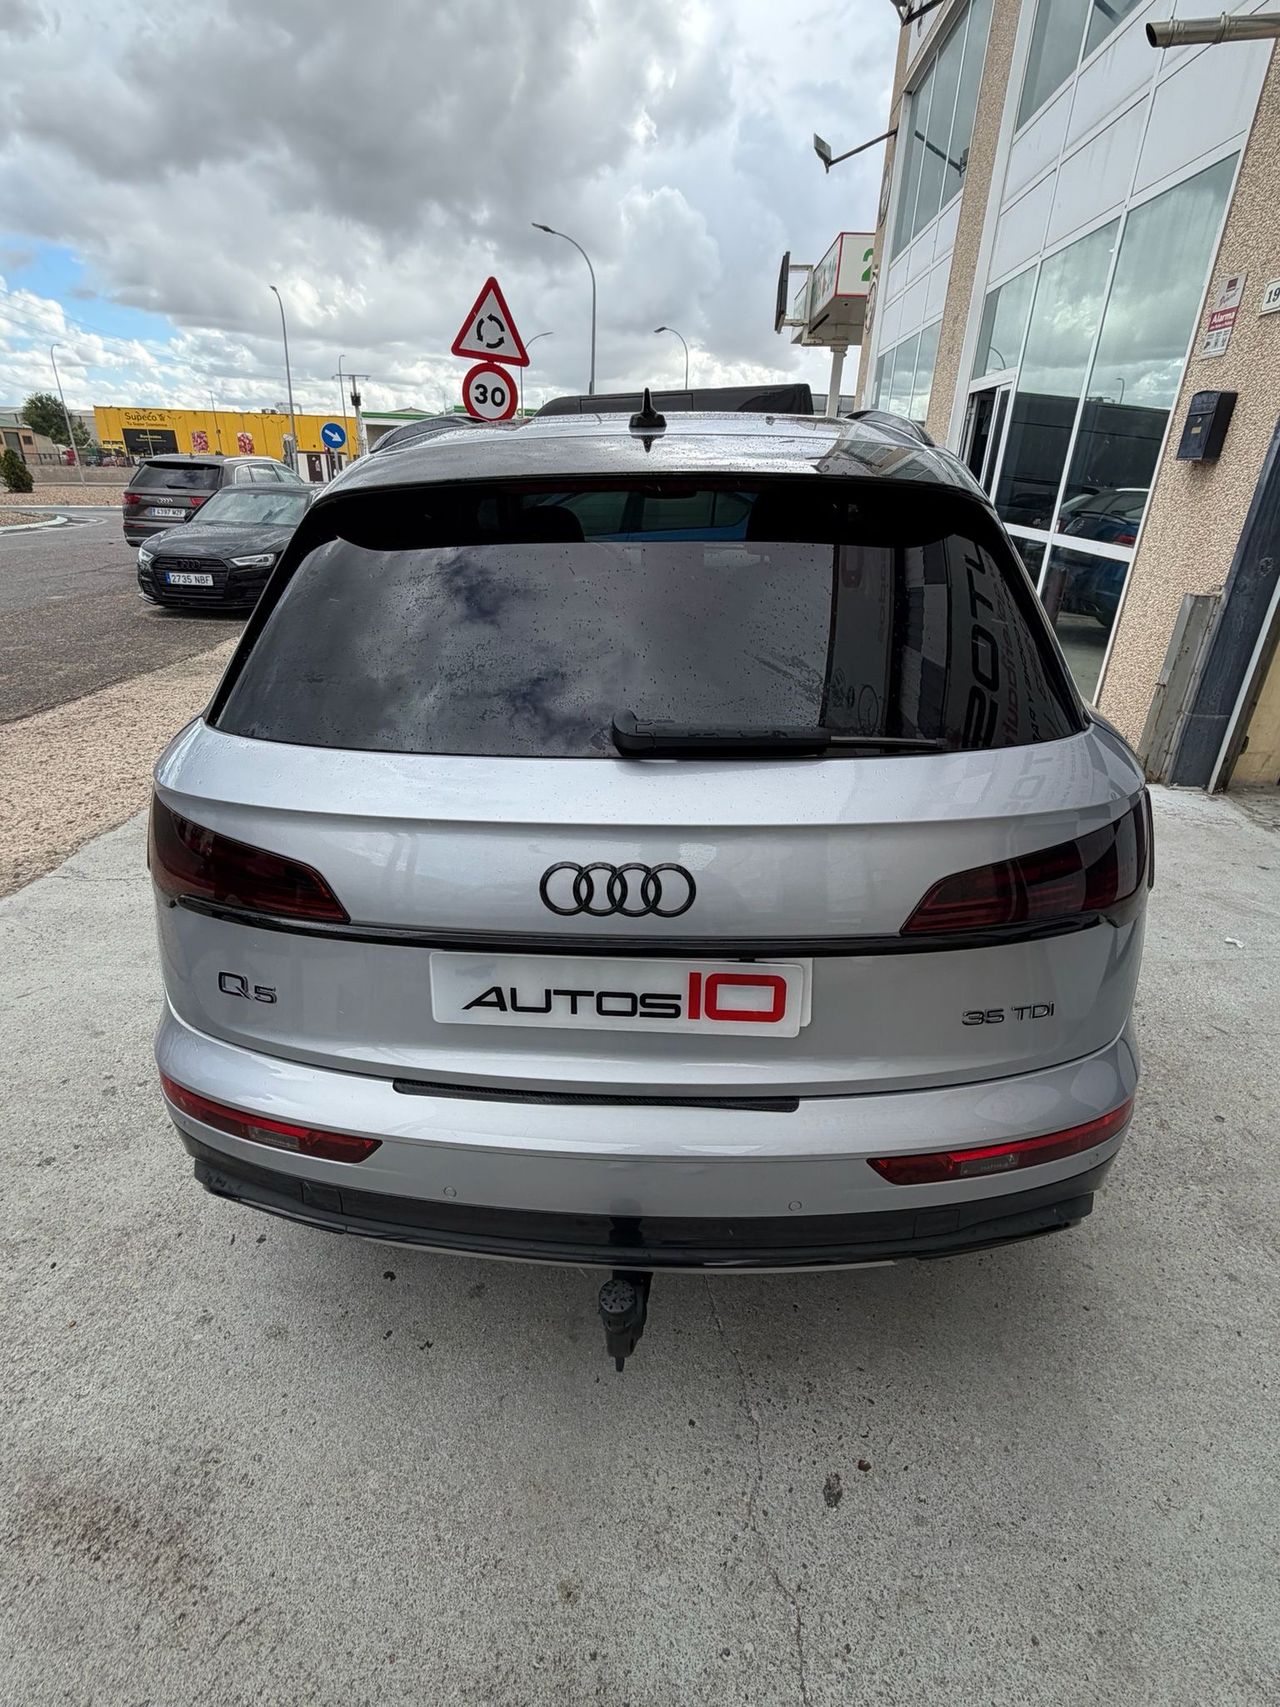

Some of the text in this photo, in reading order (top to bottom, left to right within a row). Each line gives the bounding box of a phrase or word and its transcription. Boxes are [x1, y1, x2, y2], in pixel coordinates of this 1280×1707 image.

[474, 383, 506, 407] 30
[171, 574, 211, 585] 2735 NBF
[218, 971, 277, 1004] Q5
[961, 1001, 1055, 1026] 35 TDI
